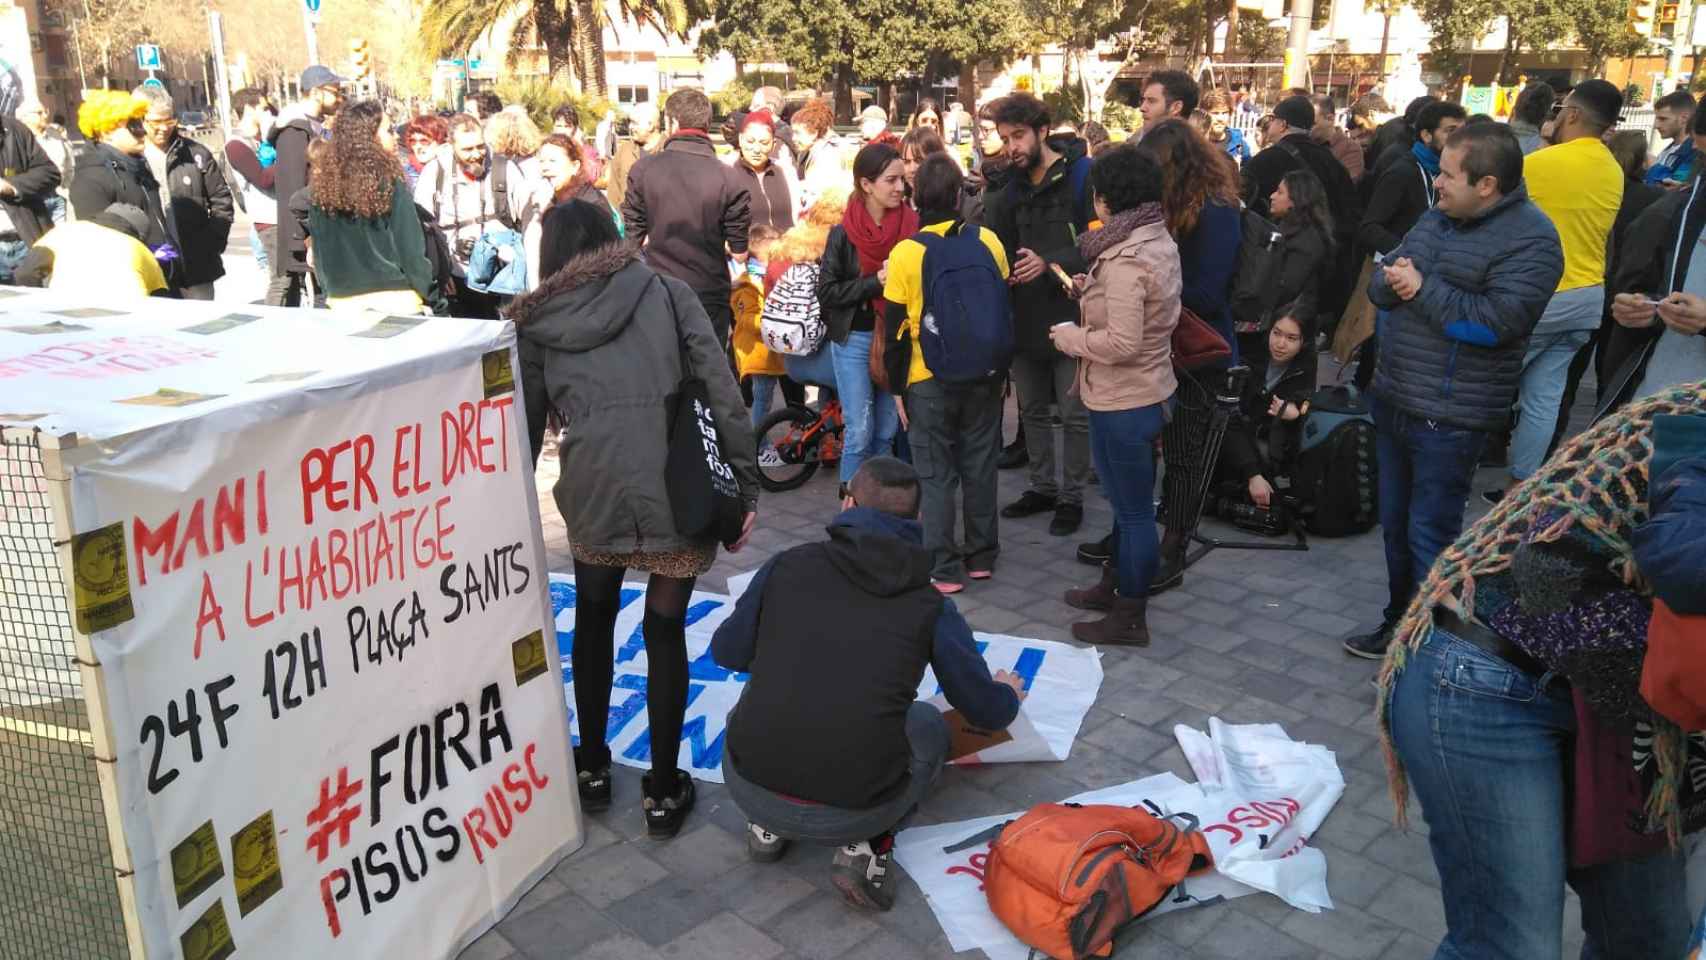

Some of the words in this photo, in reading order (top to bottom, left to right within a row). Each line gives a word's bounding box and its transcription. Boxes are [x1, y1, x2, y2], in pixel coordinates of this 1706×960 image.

[132, 468, 268, 588] MANI
[301, 433, 379, 525] PER
[393, 423, 432, 498] EL
[440, 397, 514, 488] DRET
[193, 570, 226, 660] A
[244, 495, 457, 628] L'HABITATGE
[139, 674, 240, 794] 24F
[261, 625, 328, 719] 12H
[346, 590, 430, 674] PLAÇA
[438, 541, 531, 623] SANTS
[306, 682, 513, 864] #FORA
[319, 806, 461, 939] PISOS
[462, 743, 550, 865] RUSC
